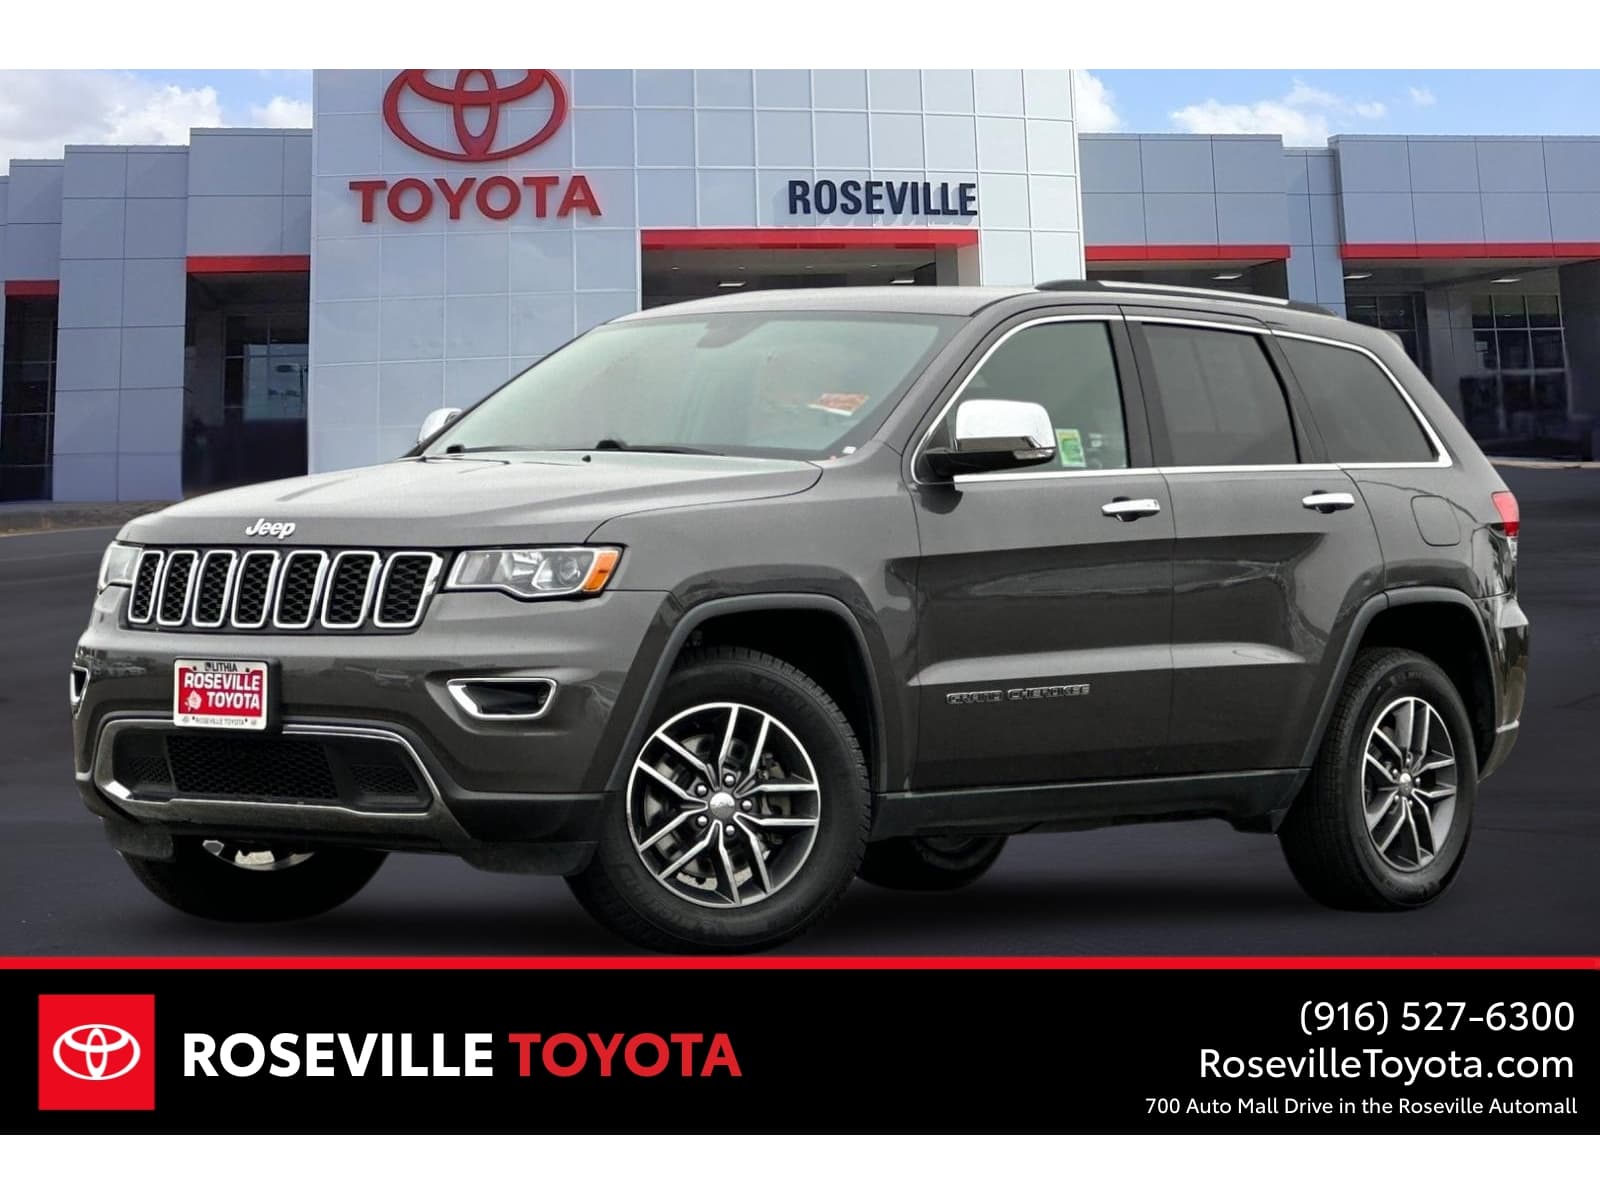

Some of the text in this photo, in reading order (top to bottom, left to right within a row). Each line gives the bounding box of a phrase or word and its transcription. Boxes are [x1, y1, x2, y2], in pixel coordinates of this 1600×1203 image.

[349, 175, 602, 223] TOYOTA
[788, 179, 978, 216] ROSEVILLE
[245, 518, 296, 539] Jeep
[212, 662, 238, 672] LITHIA
[184, 672, 261, 691] ROSEVILLE
[206, 691, 260, 709] TOYOTA
[946, 683, 1091, 704] GRAND CHEROKEE
